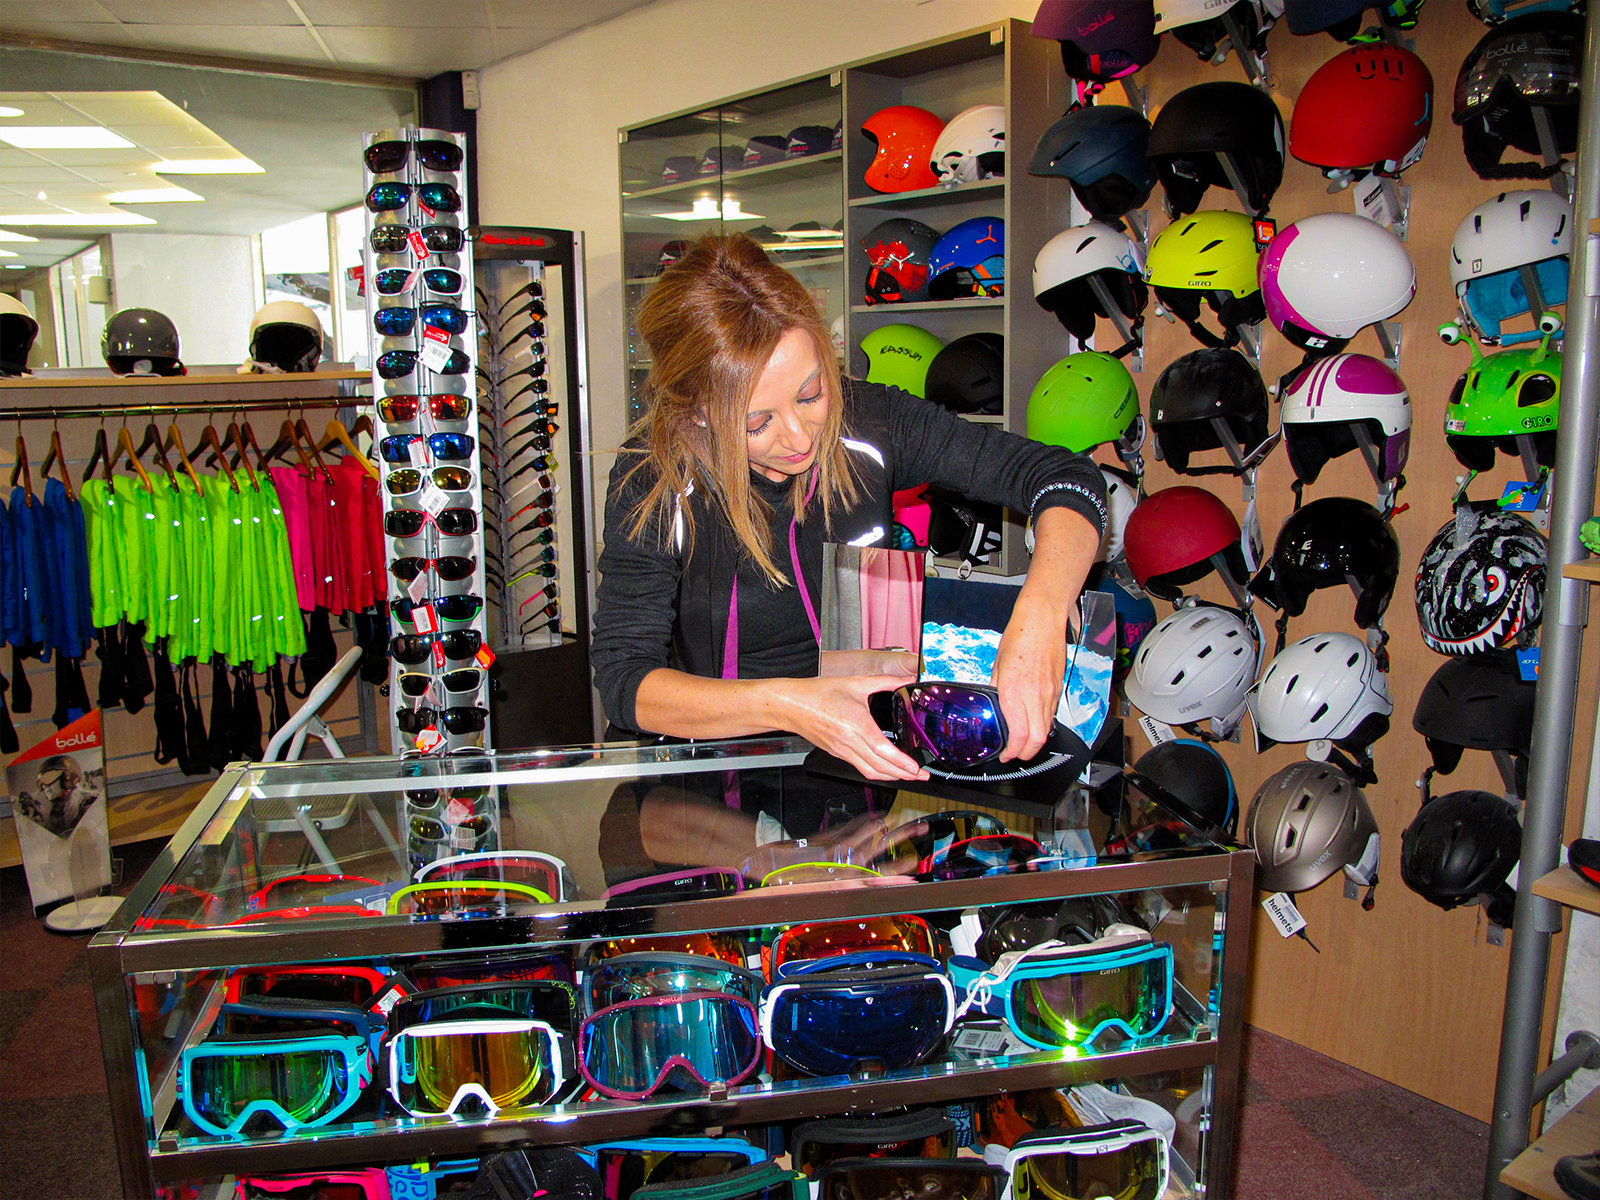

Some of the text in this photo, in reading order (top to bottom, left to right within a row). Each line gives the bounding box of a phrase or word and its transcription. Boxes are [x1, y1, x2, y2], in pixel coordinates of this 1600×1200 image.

[1486, 42, 1528, 59] bollé
[1521, 414, 1554, 429] GIRO
[1178, 700, 1203, 714] uvex
[55, 731, 97, 749] bollé
[1309, 850, 1332, 872] uvex
[674, 877, 693, 886] GIRO
[1268, 898, 1294, 933] helmets
[1100, 967, 1121, 976] GIRO
[877, 1142, 898, 1150] GIRO
